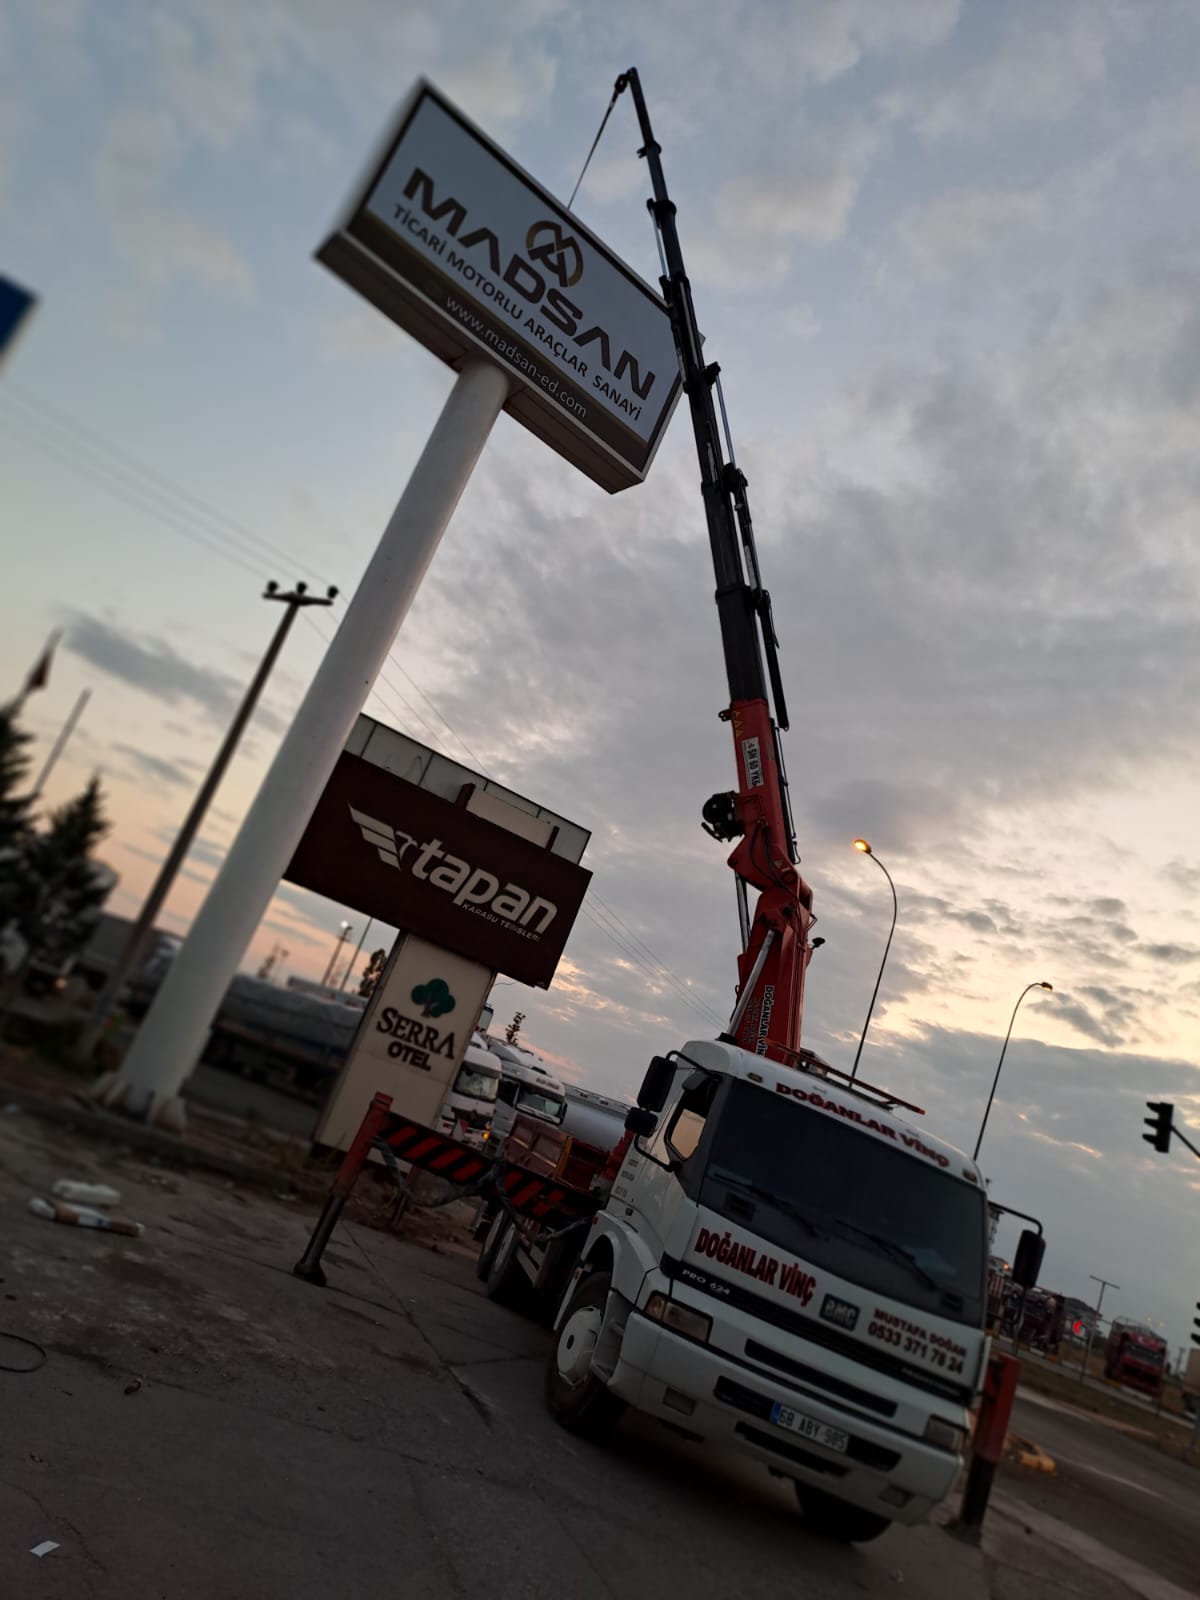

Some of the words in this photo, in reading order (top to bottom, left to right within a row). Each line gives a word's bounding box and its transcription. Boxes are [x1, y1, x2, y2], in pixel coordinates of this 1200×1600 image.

[403, 167, 656, 400] MADSAN
[394, 204, 447, 252] TİCARİ
[446, 250, 524, 320] MOTORLU
[523, 318, 588, 377] ARAÇLAR
[592, 374, 643, 421] SANAYİ
[446, 295, 588, 418] www.madsan-ed.com
[411, 838, 558, 935] tapan
[376, 1007, 456, 1060] SERRA
[387, 1043, 432, 1072] OTEL
[775, 1081, 897, 1142] DOĞANLAR
[681, 1268, 707, 1285] PRO
[694, 1226, 780, 1291] DOĞANLAR
[777, 1262, 817, 1307] VİNÇ
[825, 1296, 856, 1330] BMC
[873, 1308, 926, 1340] MUSTAFA
[867, 1321, 903, 1348] 0533
[904, 1337, 928, 1361] 371
[778, 1407, 795, 1427] 68
